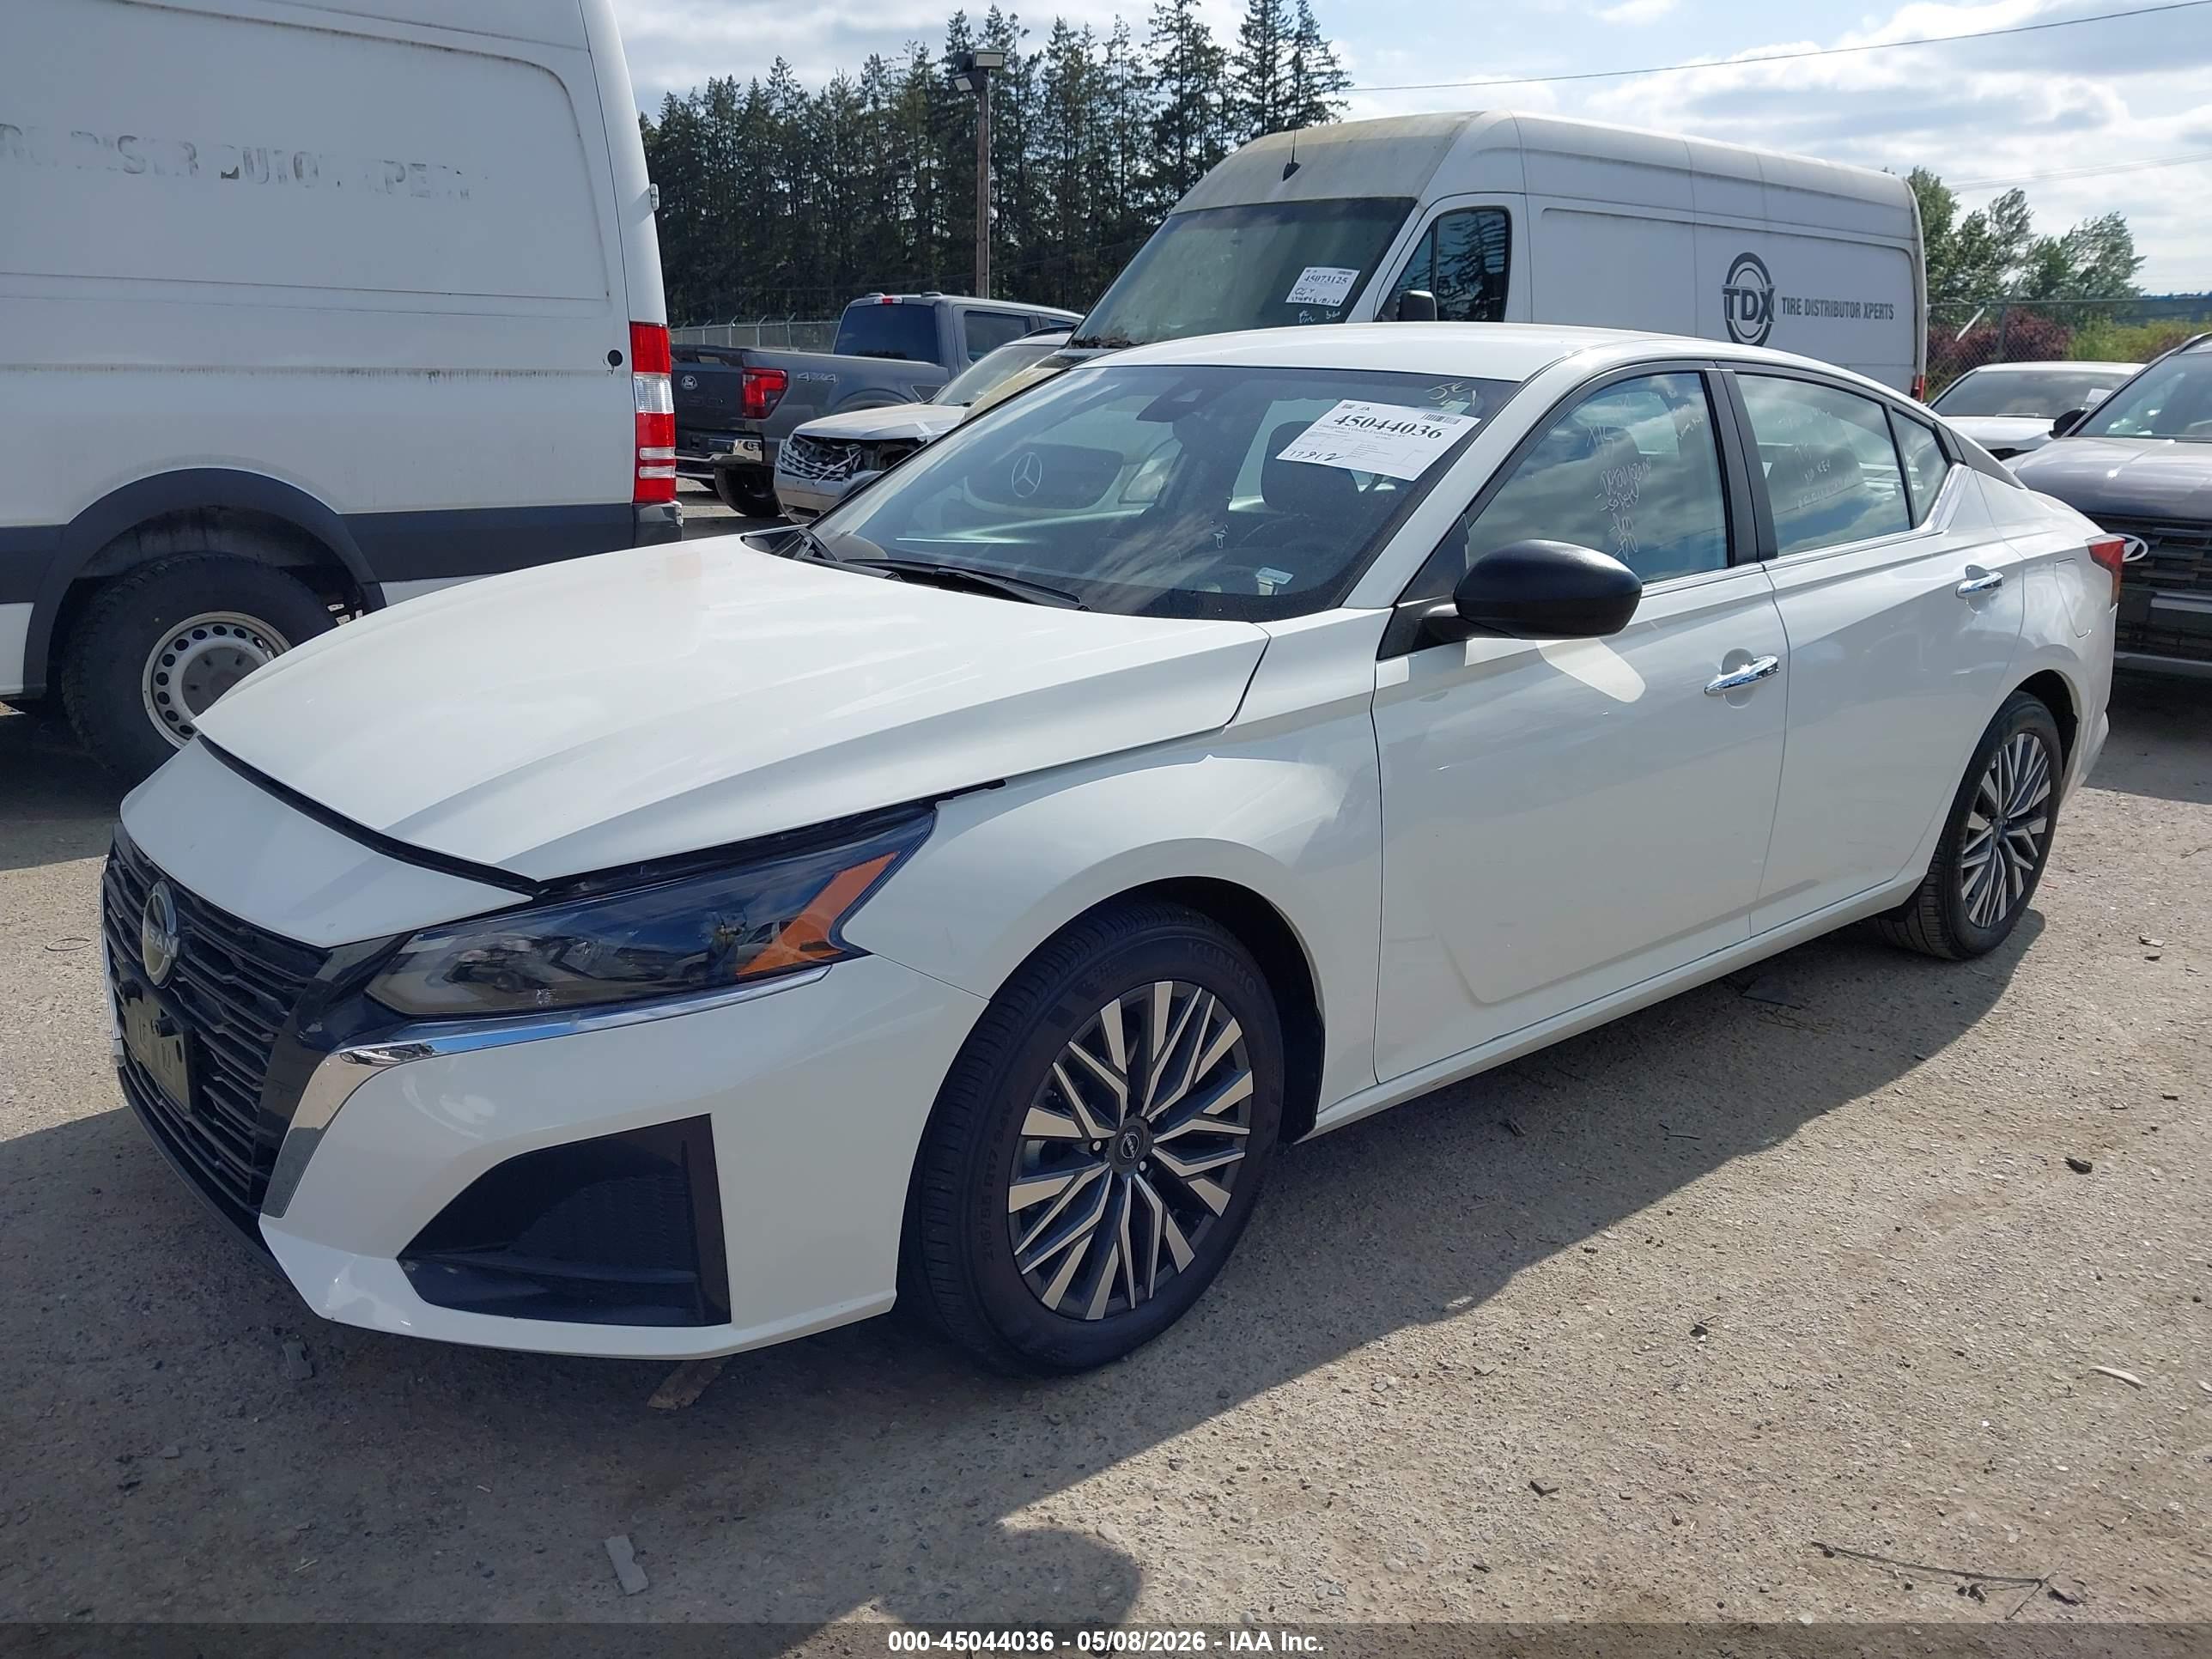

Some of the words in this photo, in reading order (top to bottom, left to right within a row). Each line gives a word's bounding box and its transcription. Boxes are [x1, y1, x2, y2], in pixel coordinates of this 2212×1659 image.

[1722, 287, 1776, 325] TDX
[1782, 296, 1802, 315] TIRE
[1804, 298, 1862, 319] DISTRIBUTOR
[1863, 301, 1894, 320] XPERTS
[1333, 414, 1448, 441] 45044036
